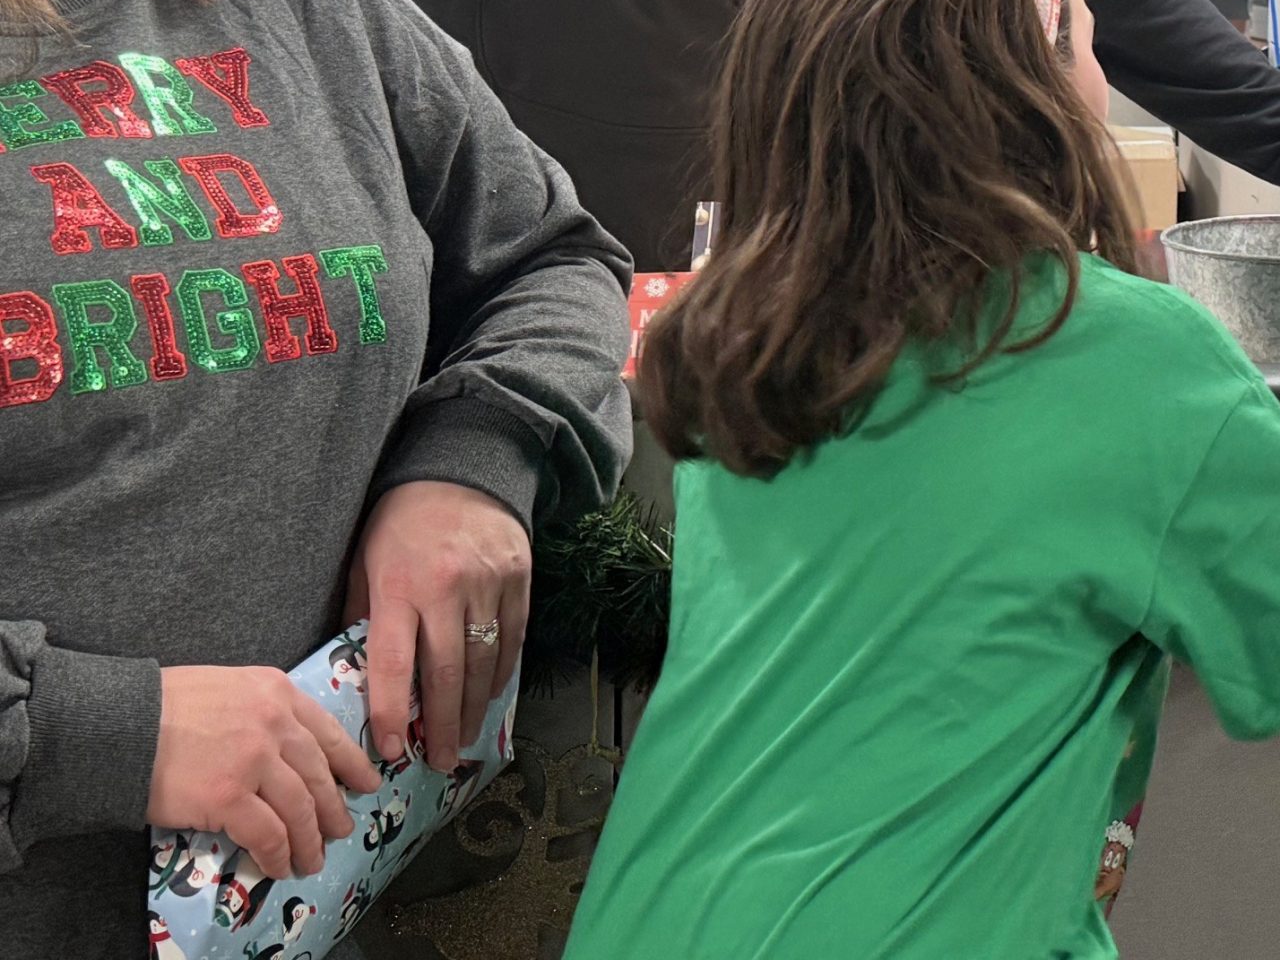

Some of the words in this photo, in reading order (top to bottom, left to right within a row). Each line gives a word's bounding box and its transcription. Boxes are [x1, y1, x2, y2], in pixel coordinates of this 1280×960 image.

[0, 48, 270, 152] ERRY
[31, 153, 283, 255] AND
[0, 245, 389, 408] BRIGHT
